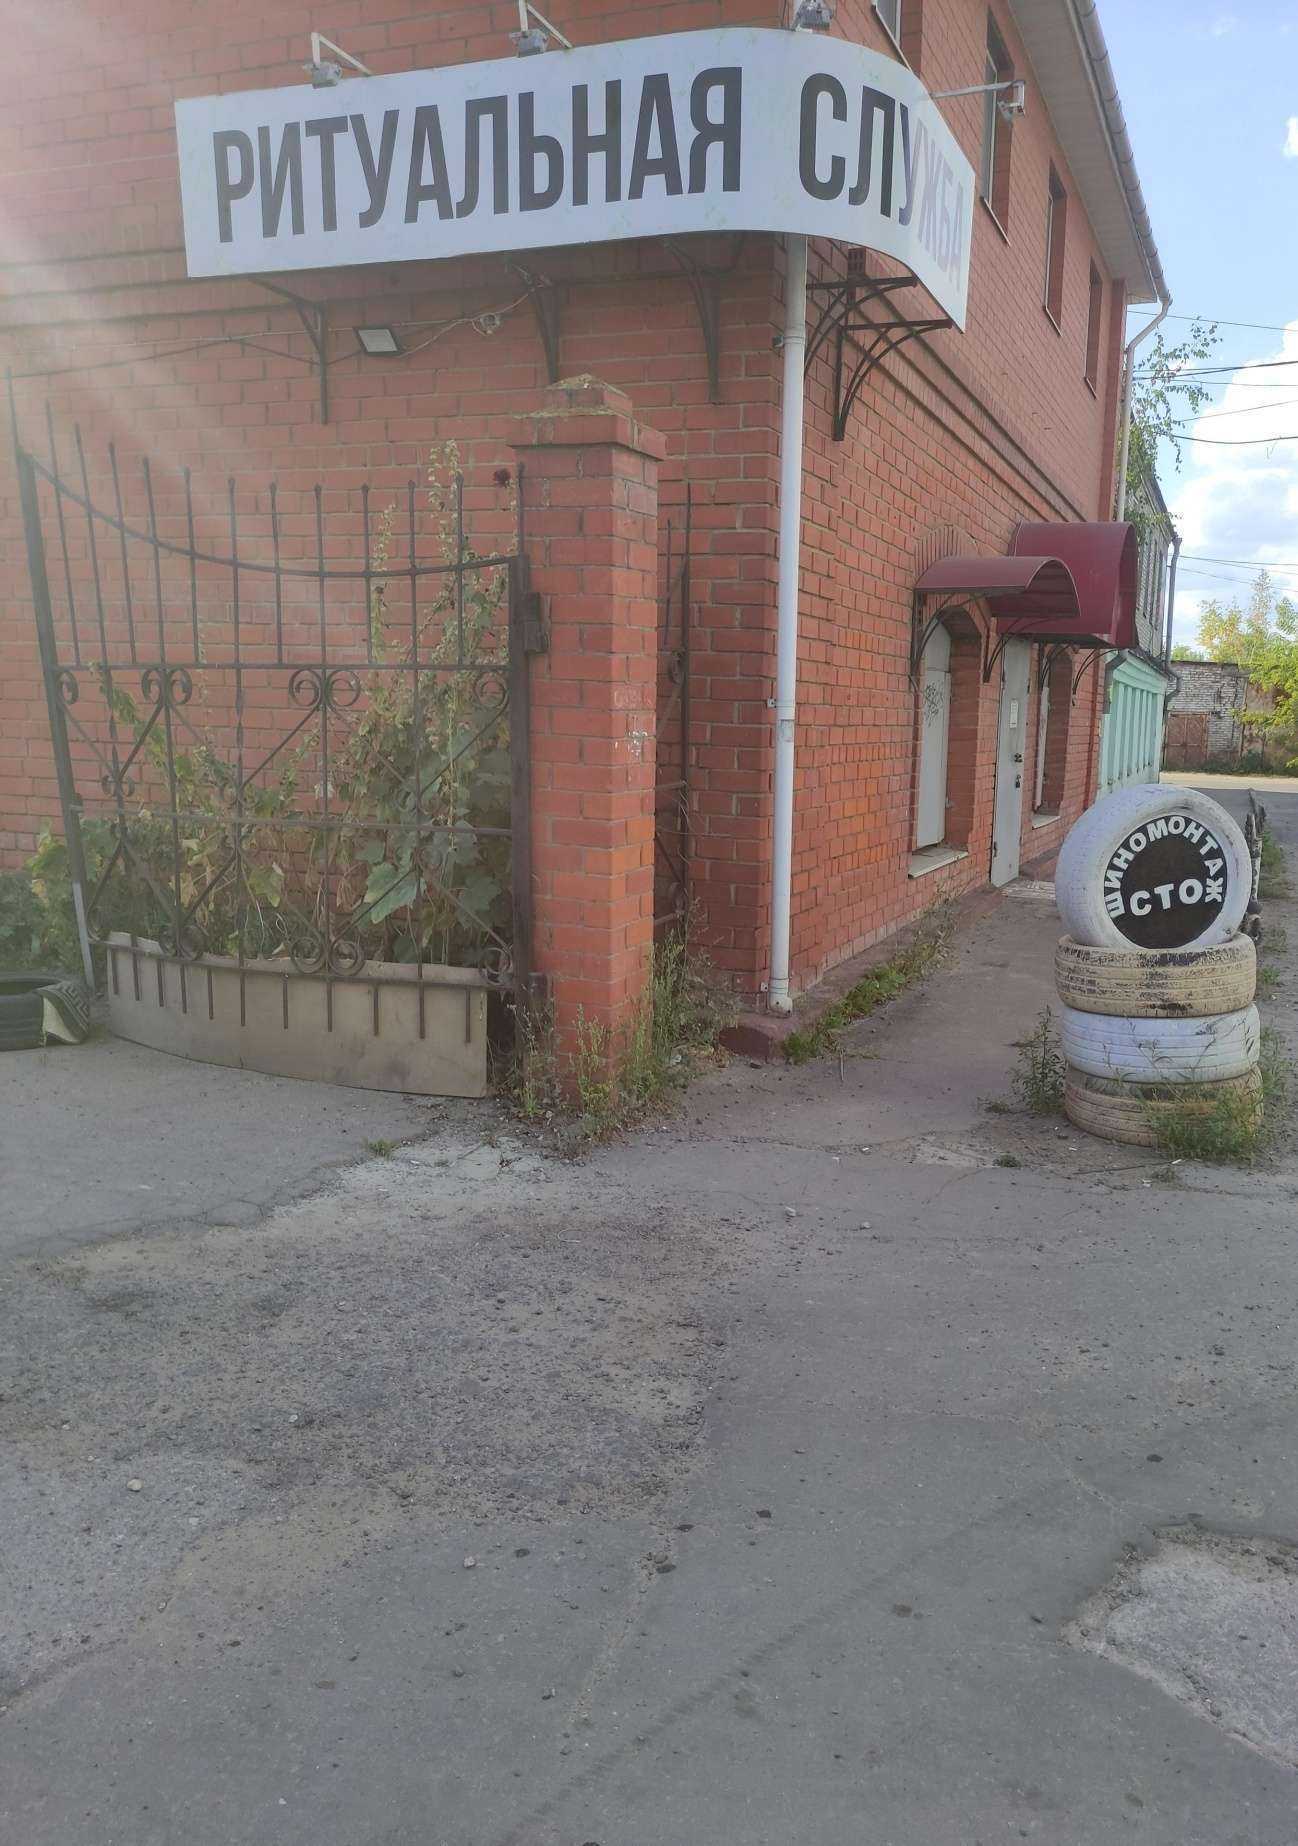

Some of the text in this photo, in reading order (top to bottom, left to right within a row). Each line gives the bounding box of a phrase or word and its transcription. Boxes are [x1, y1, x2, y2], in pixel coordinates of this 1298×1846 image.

[212, 66, 964, 293] РИТУАЛЬНАЯ СЛУЖБА
[1105, 815, 1224, 918] ШИНОМОНТАЖ
[1129, 878, 1204, 916] СТО
